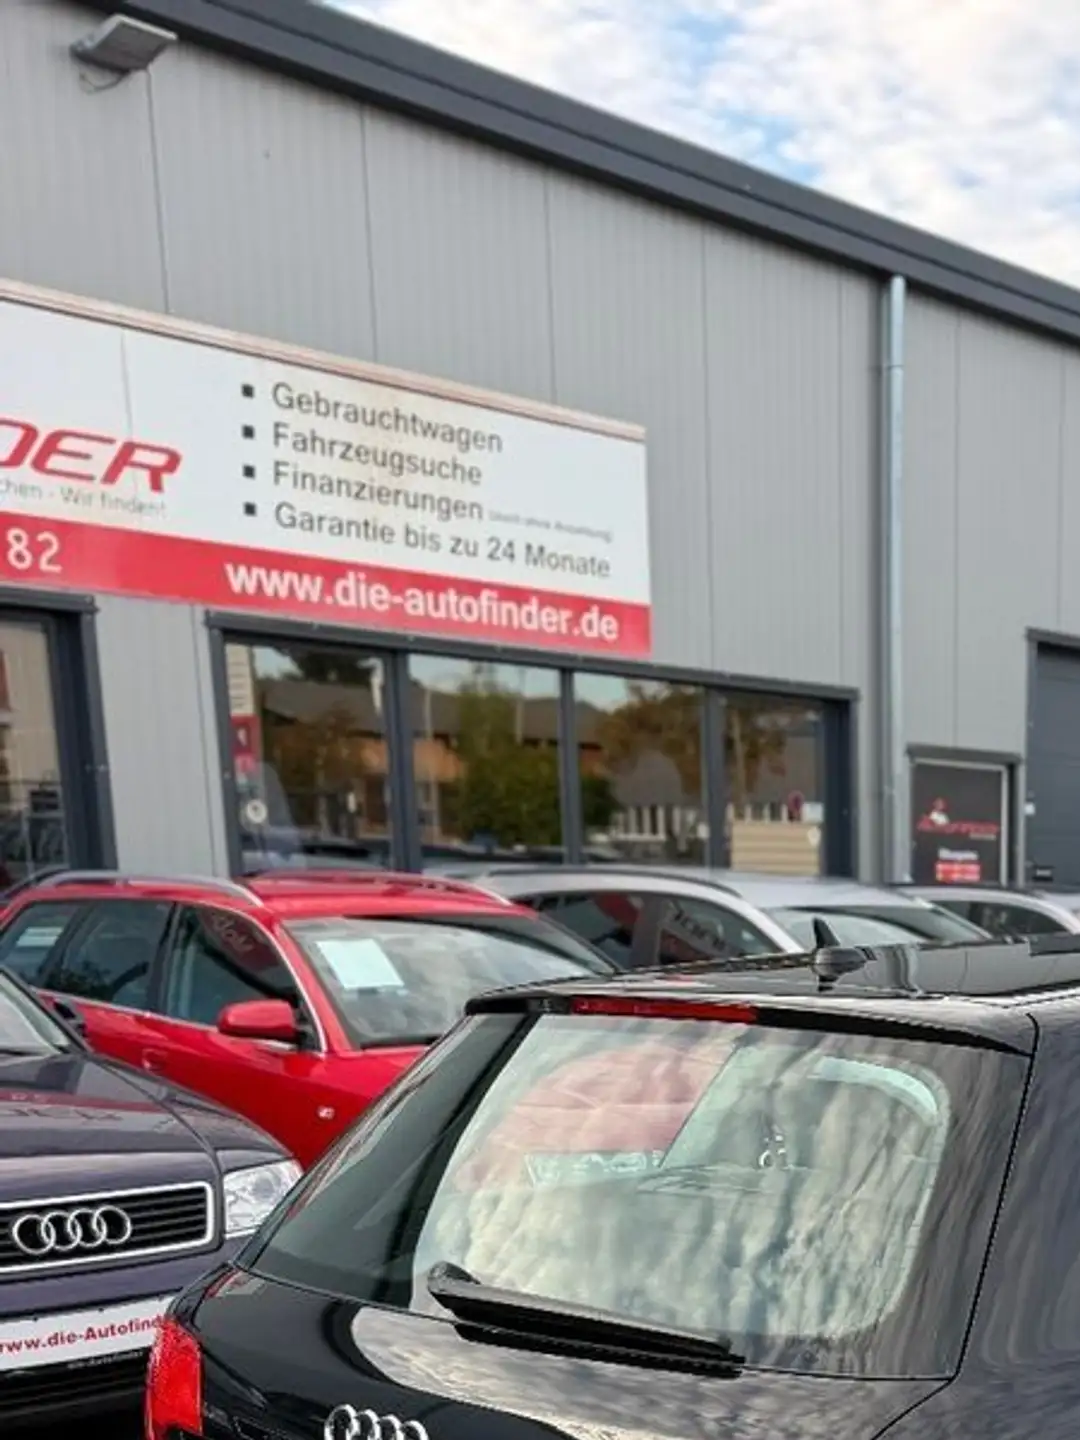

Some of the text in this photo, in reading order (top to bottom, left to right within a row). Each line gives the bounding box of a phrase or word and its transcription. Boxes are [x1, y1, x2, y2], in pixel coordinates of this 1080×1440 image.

[271, 381, 503, 453] Gebrauchtwagen
[272, 421, 483, 486] Fahrzeugsuche
[272, 460, 484, 522] Finanzierungen
[7, 527, 63, 574] 82
[274, 501, 611, 578] Garantie bis zu 24 Monate
[224, 562, 619, 641] www.die-autofinder.de
[0, 1314, 162, 1353] ww.die-Autofind
